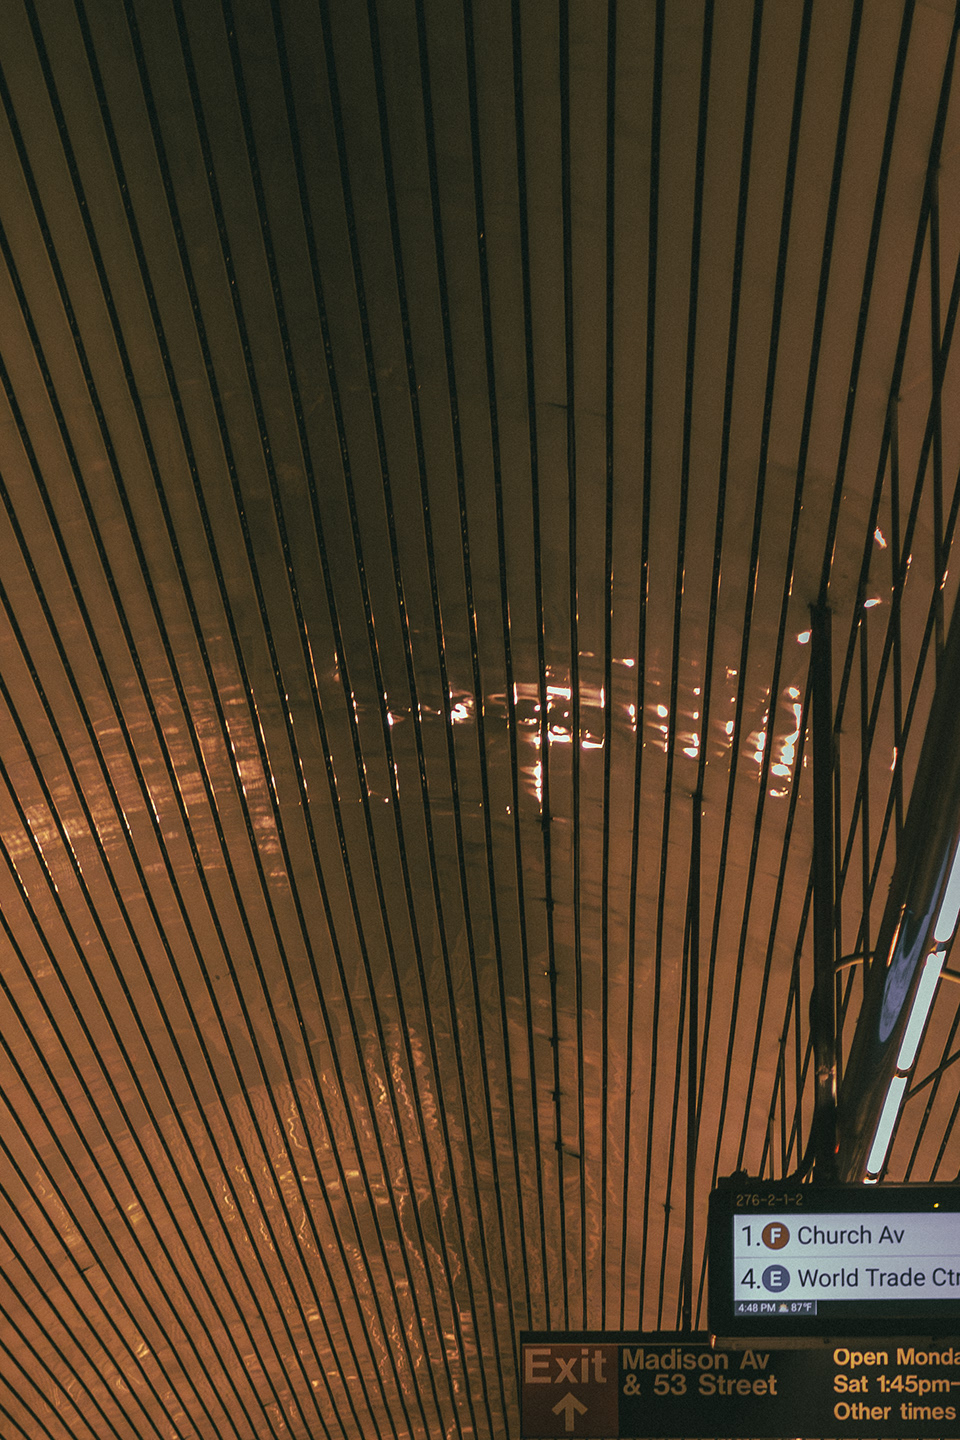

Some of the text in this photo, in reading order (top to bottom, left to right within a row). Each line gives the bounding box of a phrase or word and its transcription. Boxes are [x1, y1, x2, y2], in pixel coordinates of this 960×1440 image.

[736, 1193, 803, 1206] 276-2-1-2
[741, 1225, 905, 1246] 1. F Church Av
[740, 1268, 761, 1289] 4.
[770, 1271, 782, 1287] E
[797, 1268, 859, 1287] World
[865, 1267, 926, 1287] Trade
[738, 1303, 759, 1313] 4:48
[760, 1303, 776, 1312] PM
[524, 1348, 607, 1384] Exit
[622, 1348, 770, 1370] Madison Av
[833, 1347, 889, 1369] Open
[622, 1373, 778, 1396] & 53 Street
[833, 1374, 869, 1393] Sat
[833, 1402, 957, 1420] Other times
